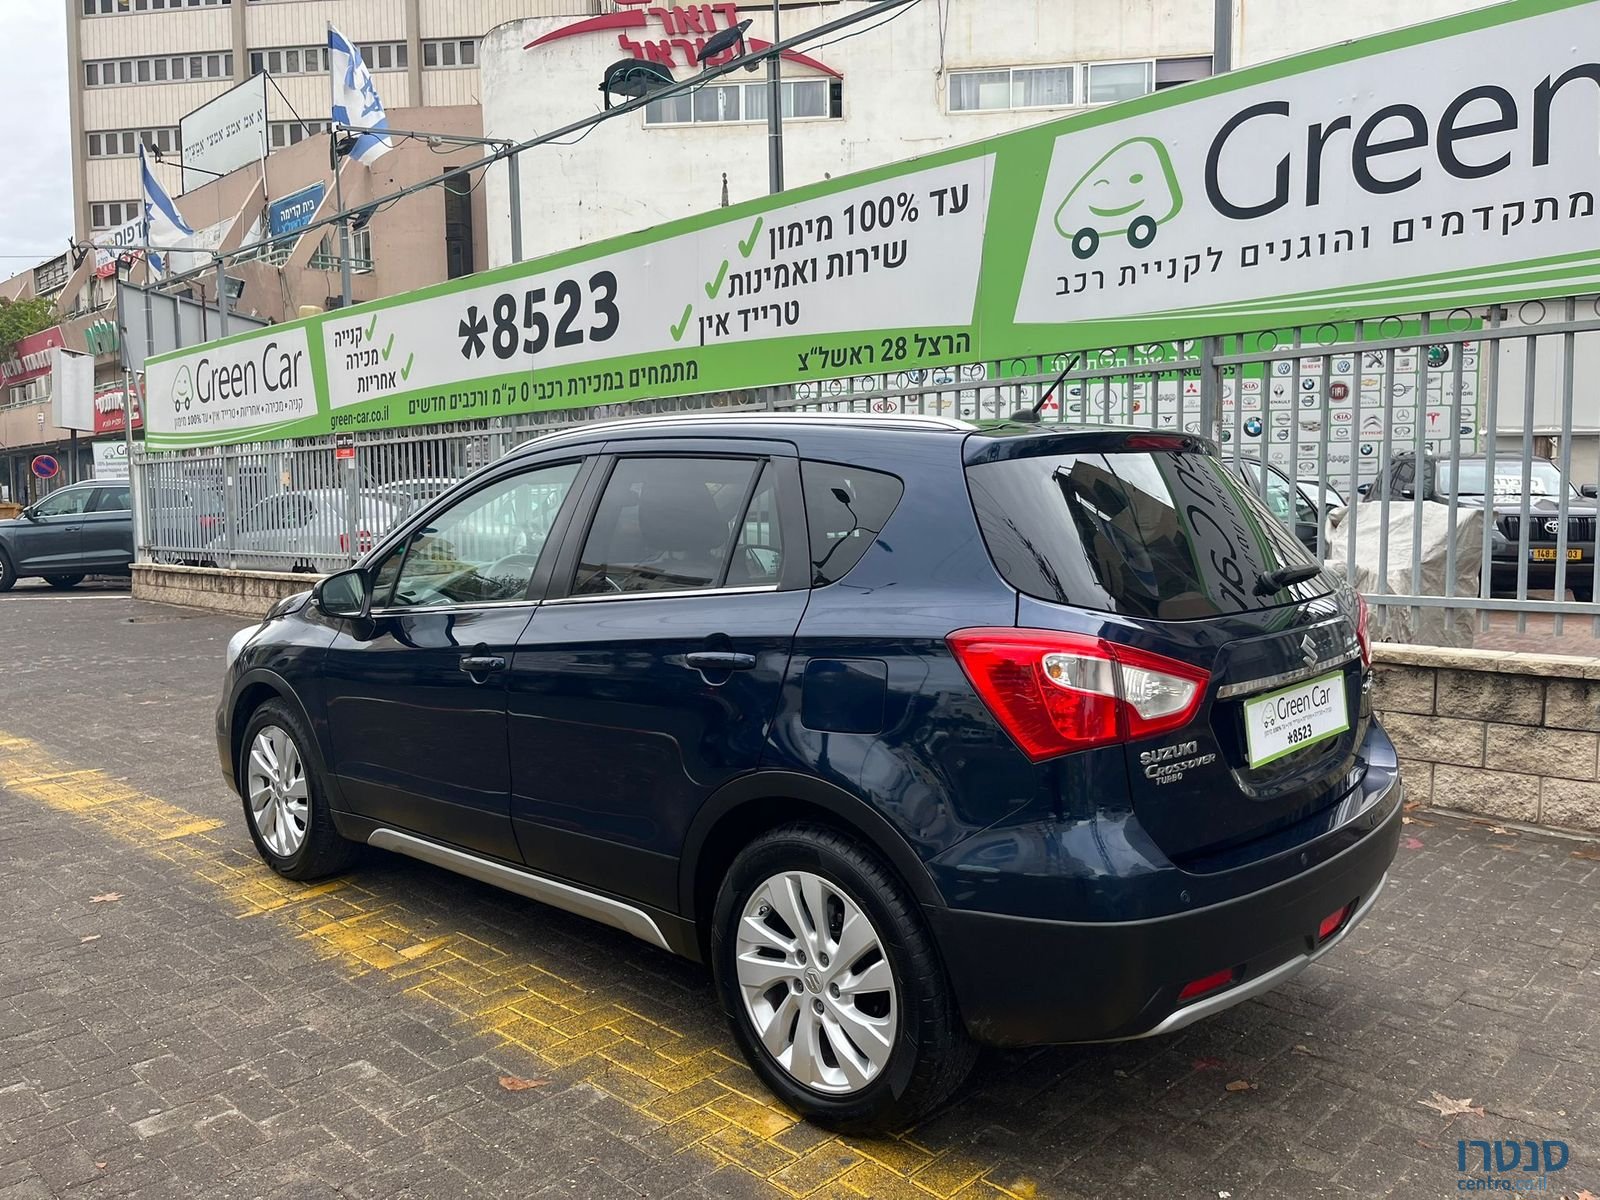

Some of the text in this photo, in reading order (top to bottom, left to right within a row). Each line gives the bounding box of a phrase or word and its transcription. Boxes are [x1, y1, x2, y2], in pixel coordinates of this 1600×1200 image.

[648, 2, 738, 35] דואר
[769, 183, 970, 260] עד 100% מימון
[1056, 191, 1595, 296] מתקדמים והוגנים לקניית רכב
[728, 239, 908, 299] שירות ואמינות
[698, 299, 800, 347] טרייד אין
[334, 326, 363, 349] קנייה
[881, 337, 907, 362] 28
[914, 332, 971, 359] הרצל
[346, 348, 379, 370] מכירה
[196, 342, 302, 404] Green Car
[357, 371, 397, 394] אחריות
[567, 371, 624, 396] במכירת
[629, 359, 698, 388] מתמחים
[450, 389, 488, 410] ורכבים
[520, 381, 529, 402] 0
[533, 380, 563, 401] רכבי
[330, 405, 389, 430] green-car.co.il
[408, 395, 446, 415] חדשים
[877, 403, 894, 411] KA
[1277, 694, 1311, 720] Green
[1311, 685, 1331, 707] Car
[1139, 740, 1198, 766] SUZUKI
[1155, 772, 1183, 786] TURBO
